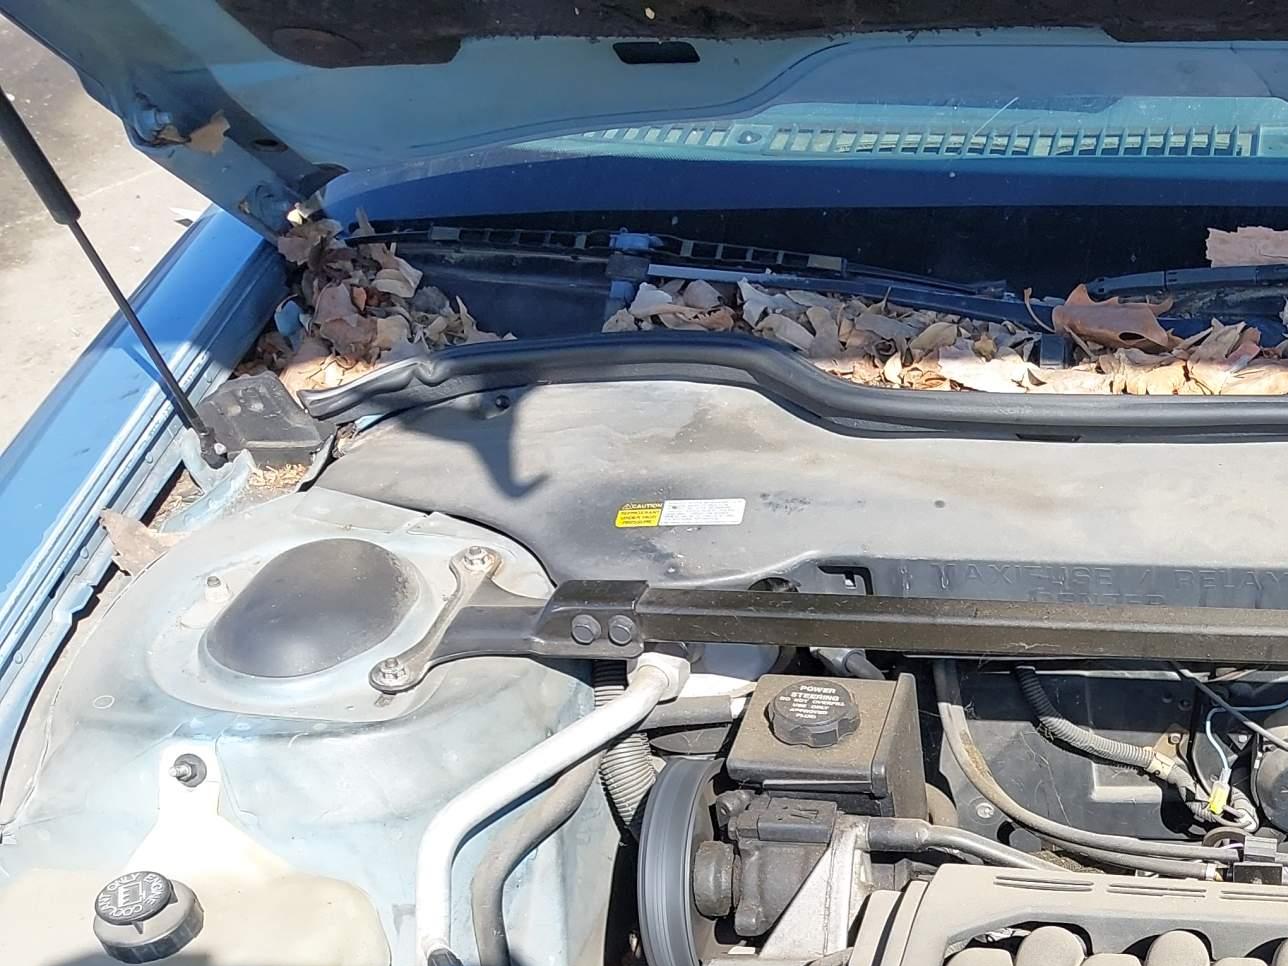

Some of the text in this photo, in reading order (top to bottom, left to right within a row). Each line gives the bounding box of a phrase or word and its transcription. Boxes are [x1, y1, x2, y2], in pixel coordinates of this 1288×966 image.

[631, 502, 663, 510] CAUTION
[799, 685, 837, 693] POWER
[790, 692, 840, 702] STEERING
